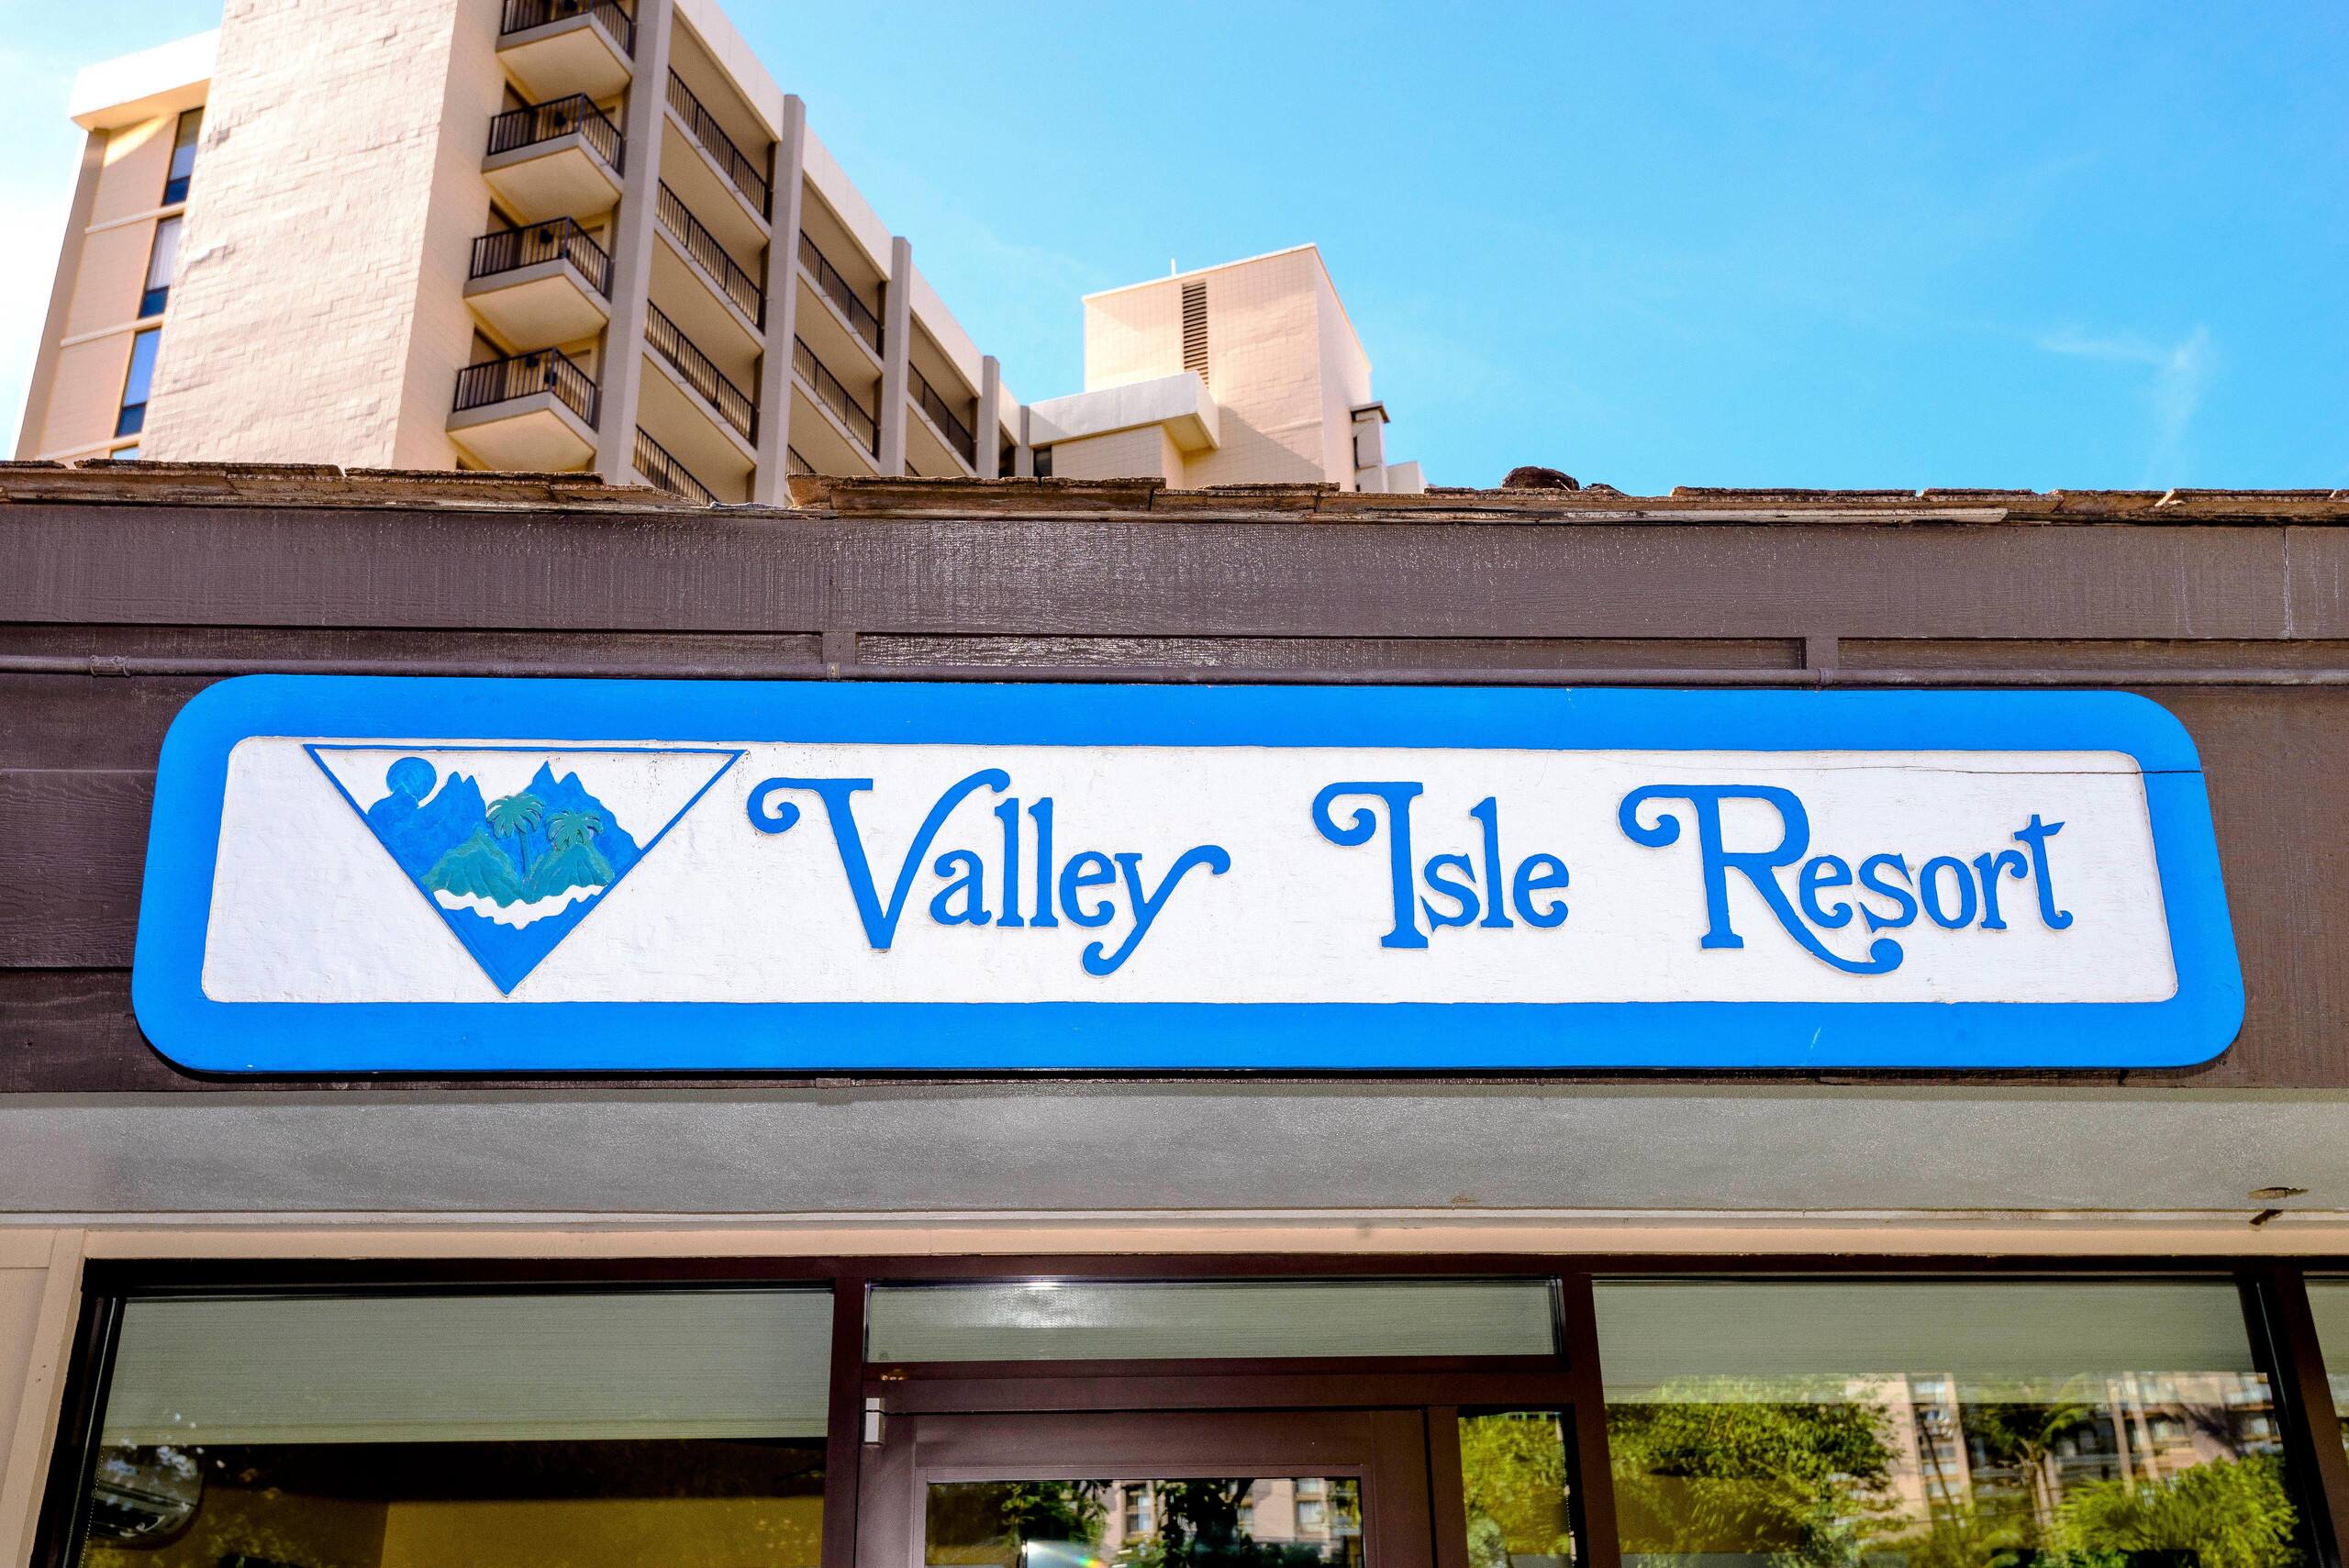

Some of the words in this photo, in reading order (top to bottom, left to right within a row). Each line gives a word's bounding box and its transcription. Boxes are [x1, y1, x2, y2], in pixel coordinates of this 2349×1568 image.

[747, 768, 1230, 977] Valley
[1314, 782, 1570, 950] Isle
[1619, 784, 2074, 975] Resort
